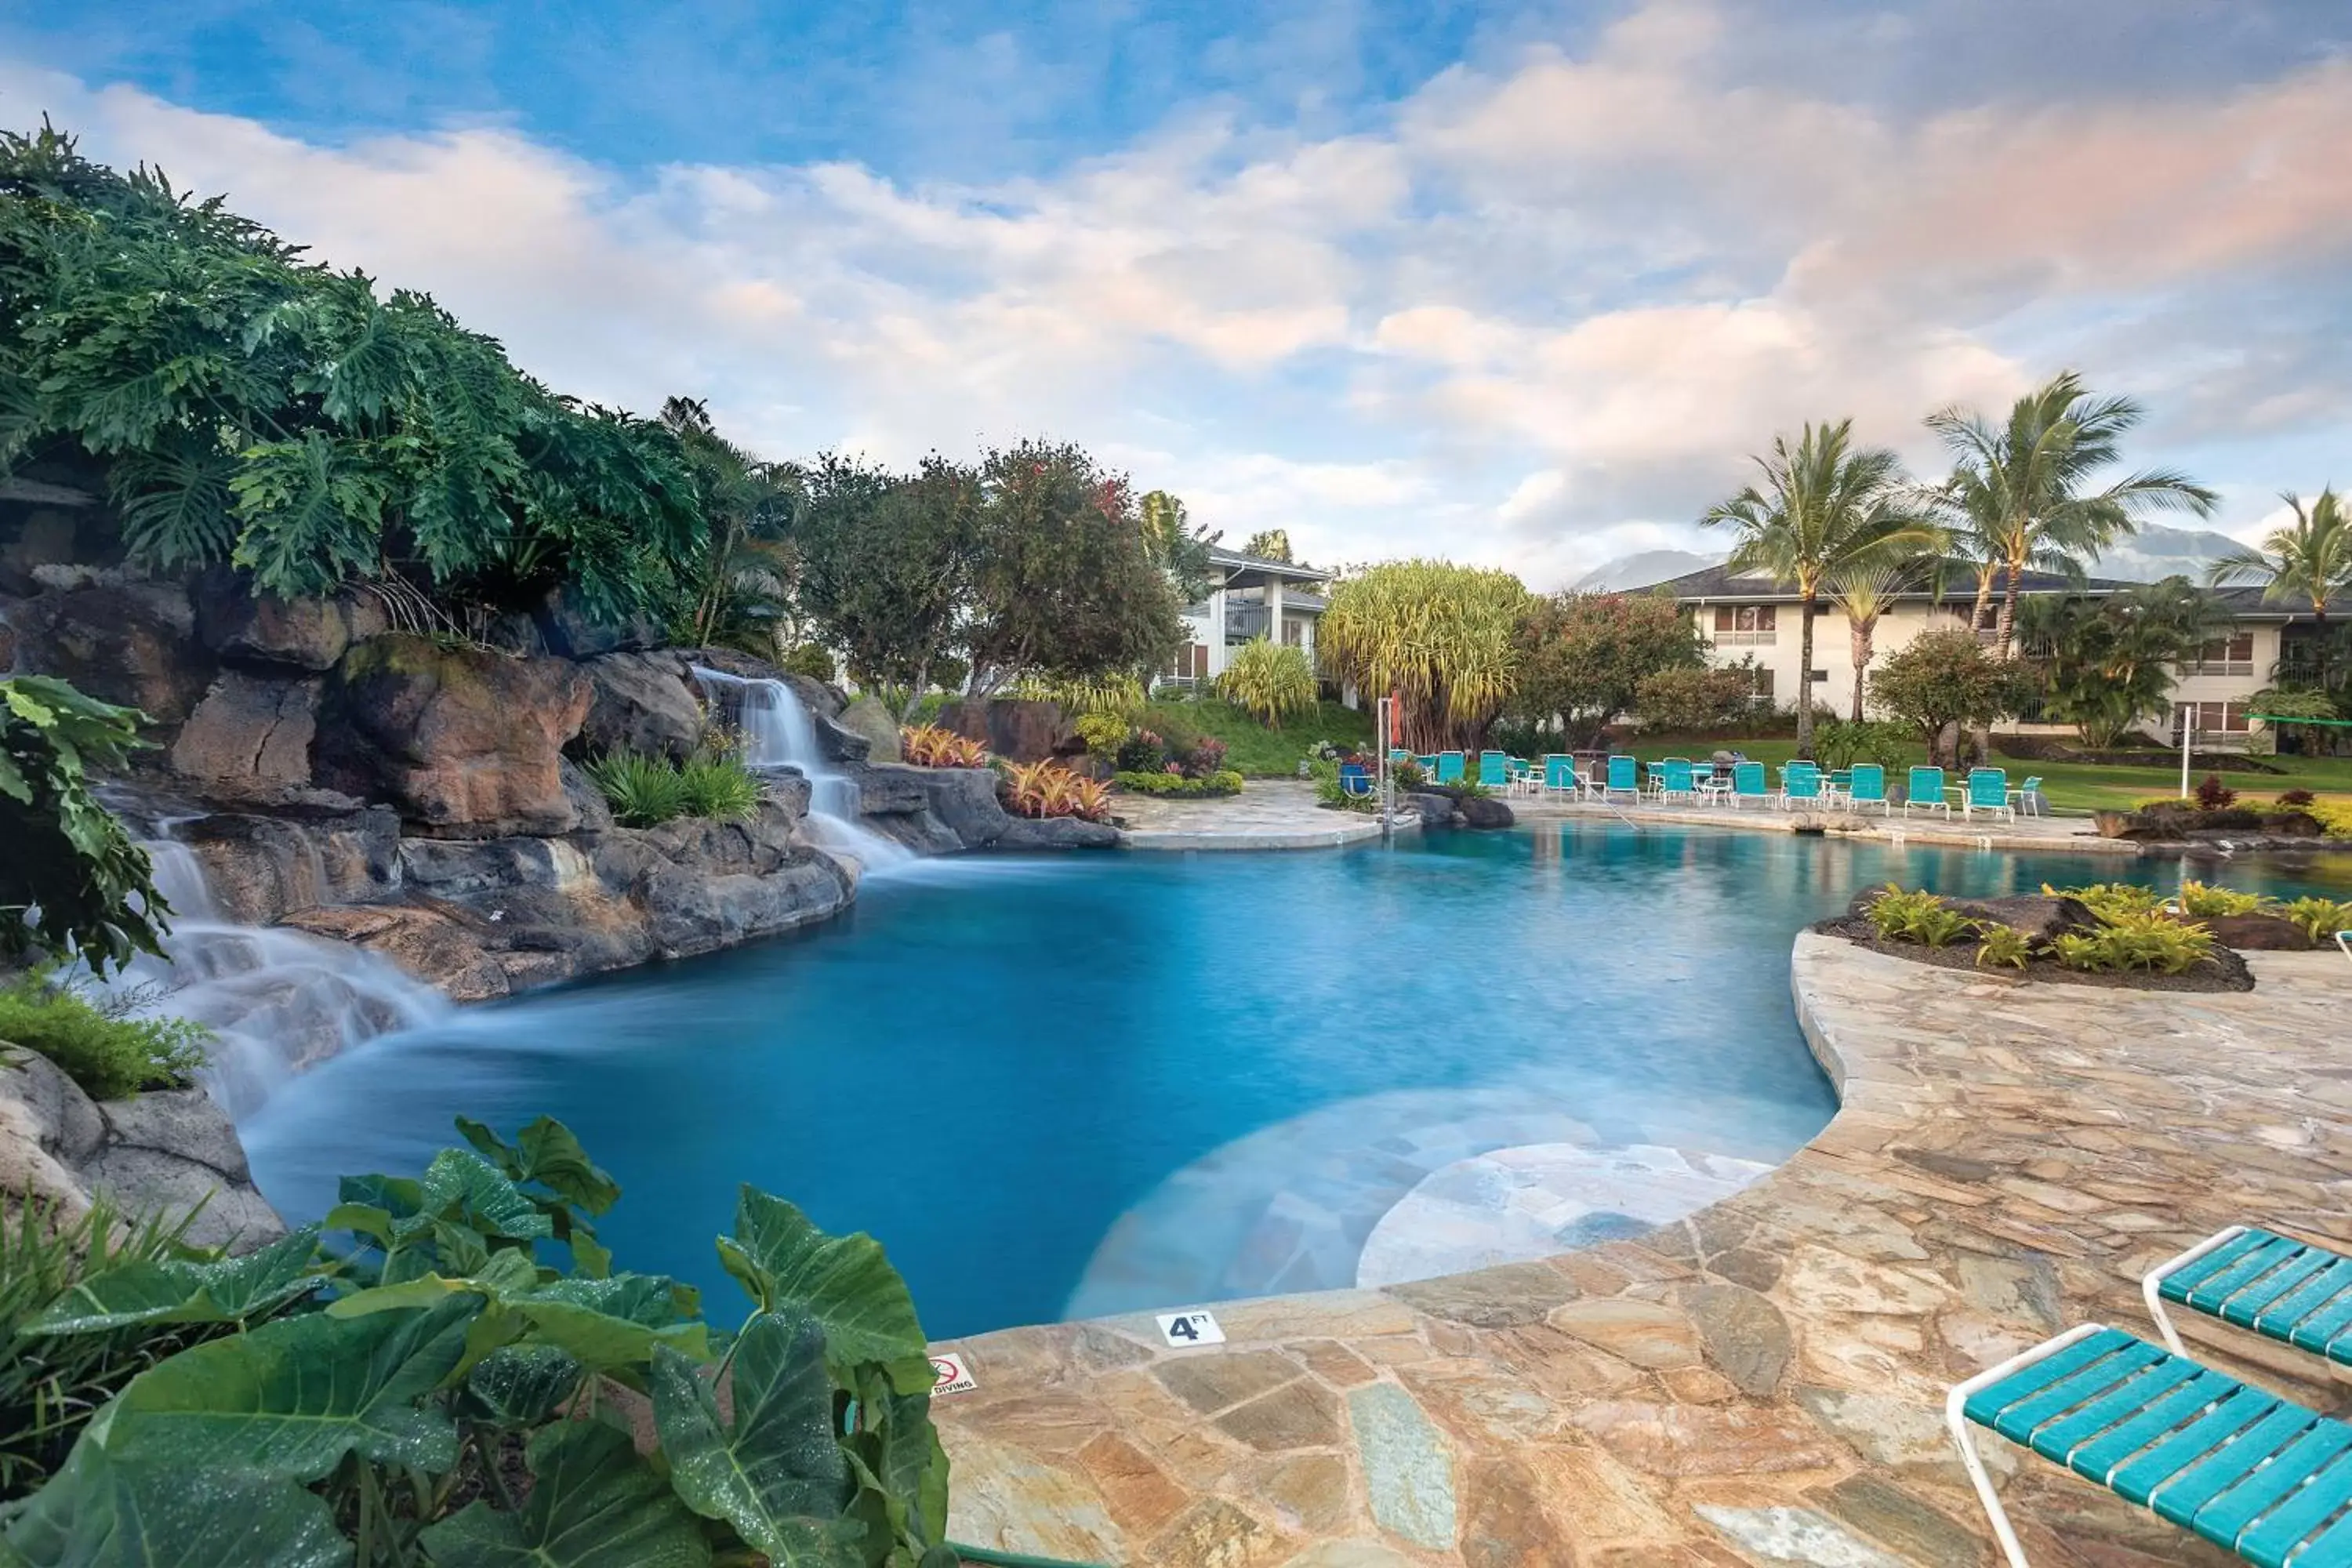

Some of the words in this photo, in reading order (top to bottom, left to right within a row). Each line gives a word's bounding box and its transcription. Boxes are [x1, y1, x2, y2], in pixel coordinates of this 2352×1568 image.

[1170, 1317, 1199, 1341] 4
[1192, 1315, 1207, 1323] FT
[935, 1381, 973, 1393] DIVING
